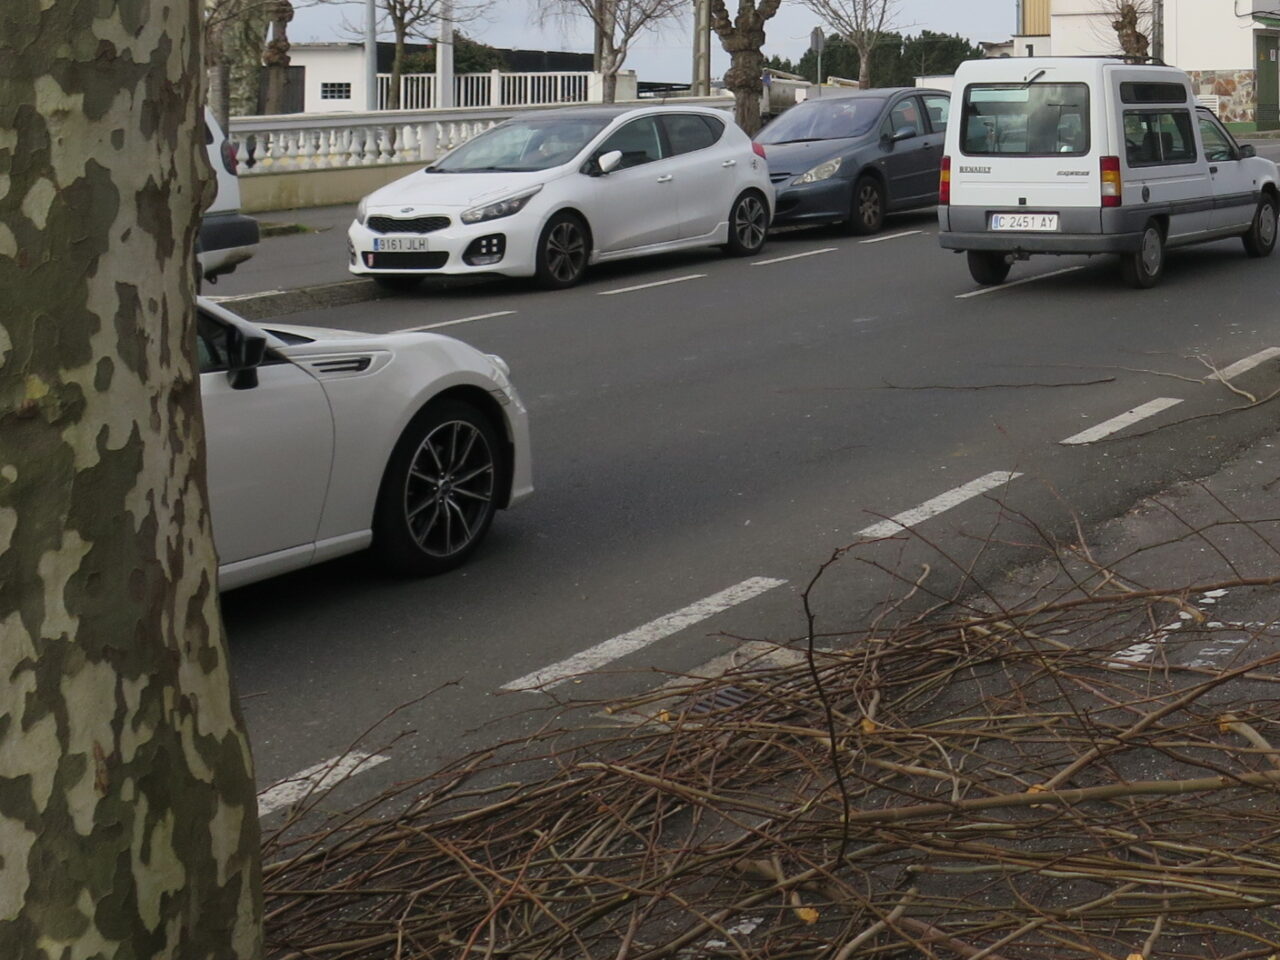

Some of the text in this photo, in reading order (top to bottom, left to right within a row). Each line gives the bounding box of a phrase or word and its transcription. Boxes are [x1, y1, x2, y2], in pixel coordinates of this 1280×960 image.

[959, 166, 992, 174] RENAULT
[999, 216, 1055, 228] C 2451 AY
[379, 239, 426, 250] 9161 JLH
